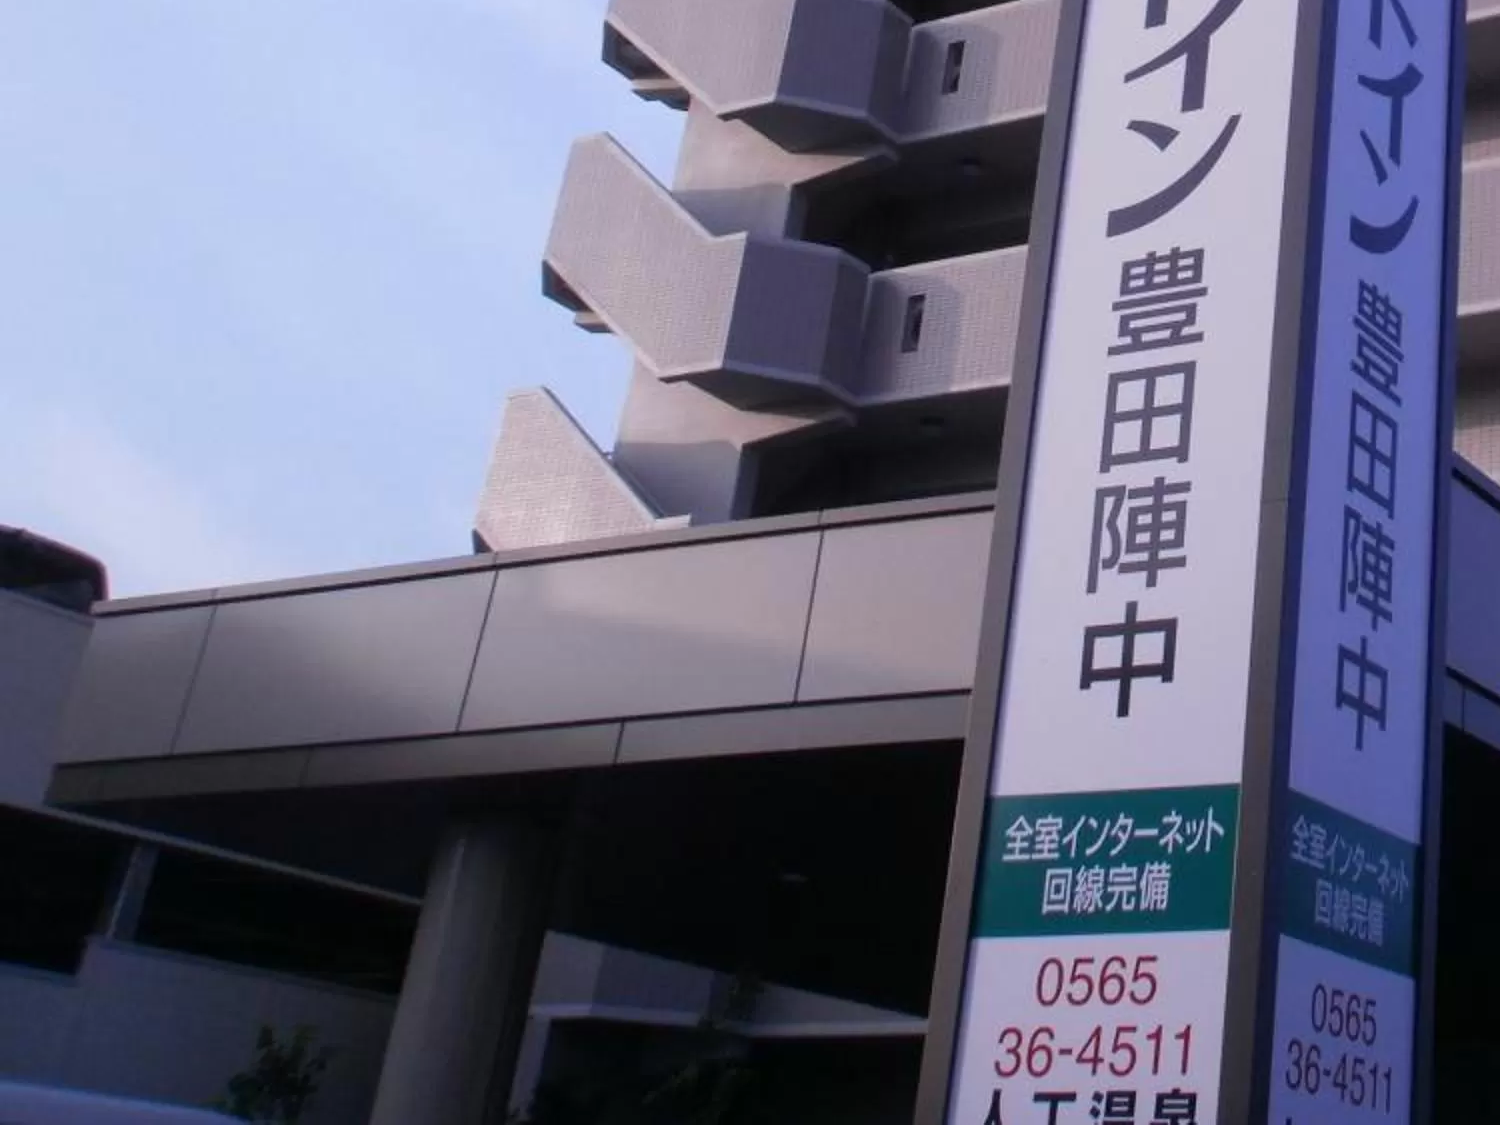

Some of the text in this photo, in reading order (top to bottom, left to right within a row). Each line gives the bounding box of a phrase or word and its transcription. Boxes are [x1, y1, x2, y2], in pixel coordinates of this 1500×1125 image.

[1002, 806, 1225, 863] 全室インターネット
[1290, 814, 1409, 903] 全室インターネット
[1041, 861, 1172, 916] 回線完備
[1036, 955, 1159, 1007] 0565
[1311, 983, 1378, 1047] 0565
[994, 1024, 1194, 1078] 36-4511
[1285, 1039, 1393, 1115] 36-4511
